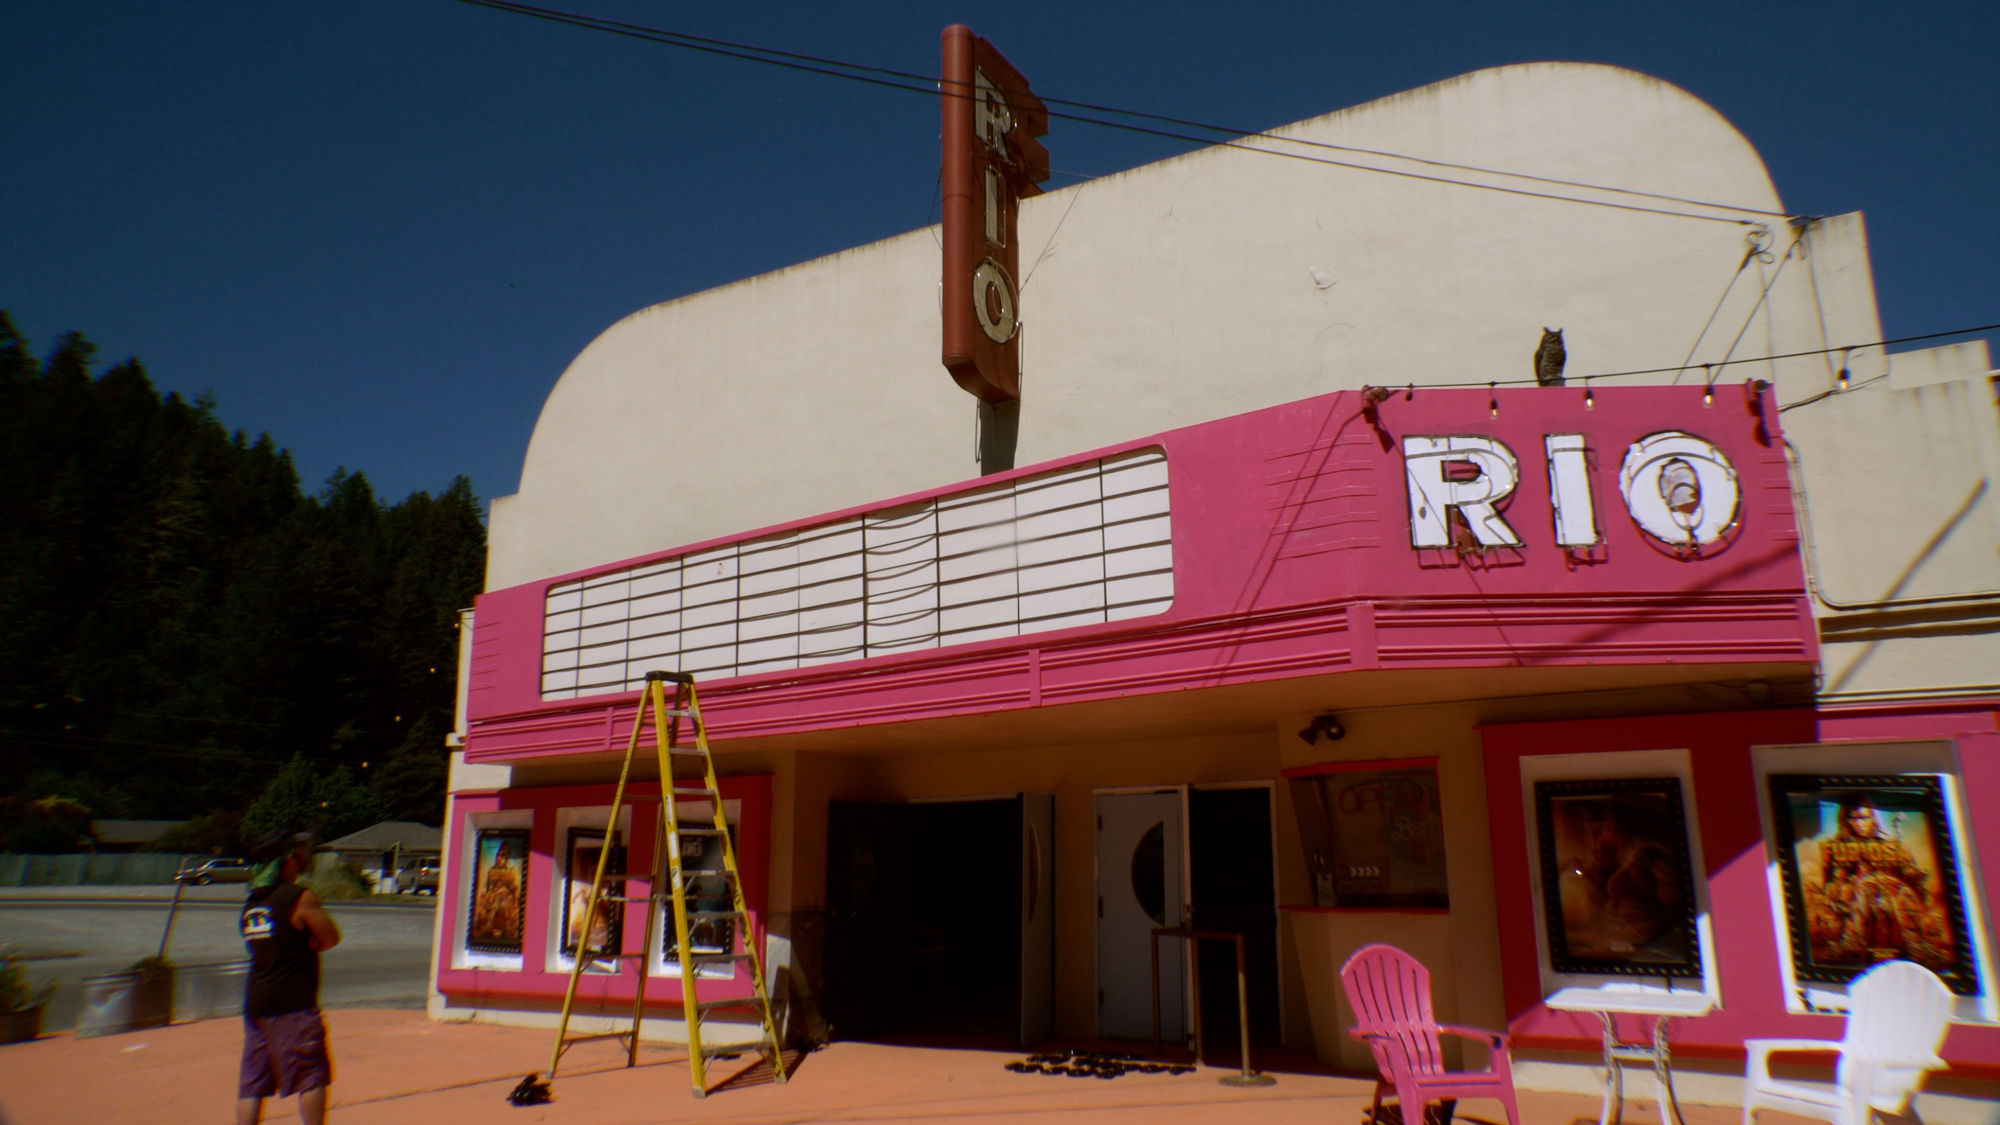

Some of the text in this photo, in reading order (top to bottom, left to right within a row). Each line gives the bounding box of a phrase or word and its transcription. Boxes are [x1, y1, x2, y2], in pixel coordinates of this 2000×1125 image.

[973, 65, 1018, 344] RIO
[1402, 430, 1744, 551] RIO
[1338, 784, 1419, 814] OPEN
